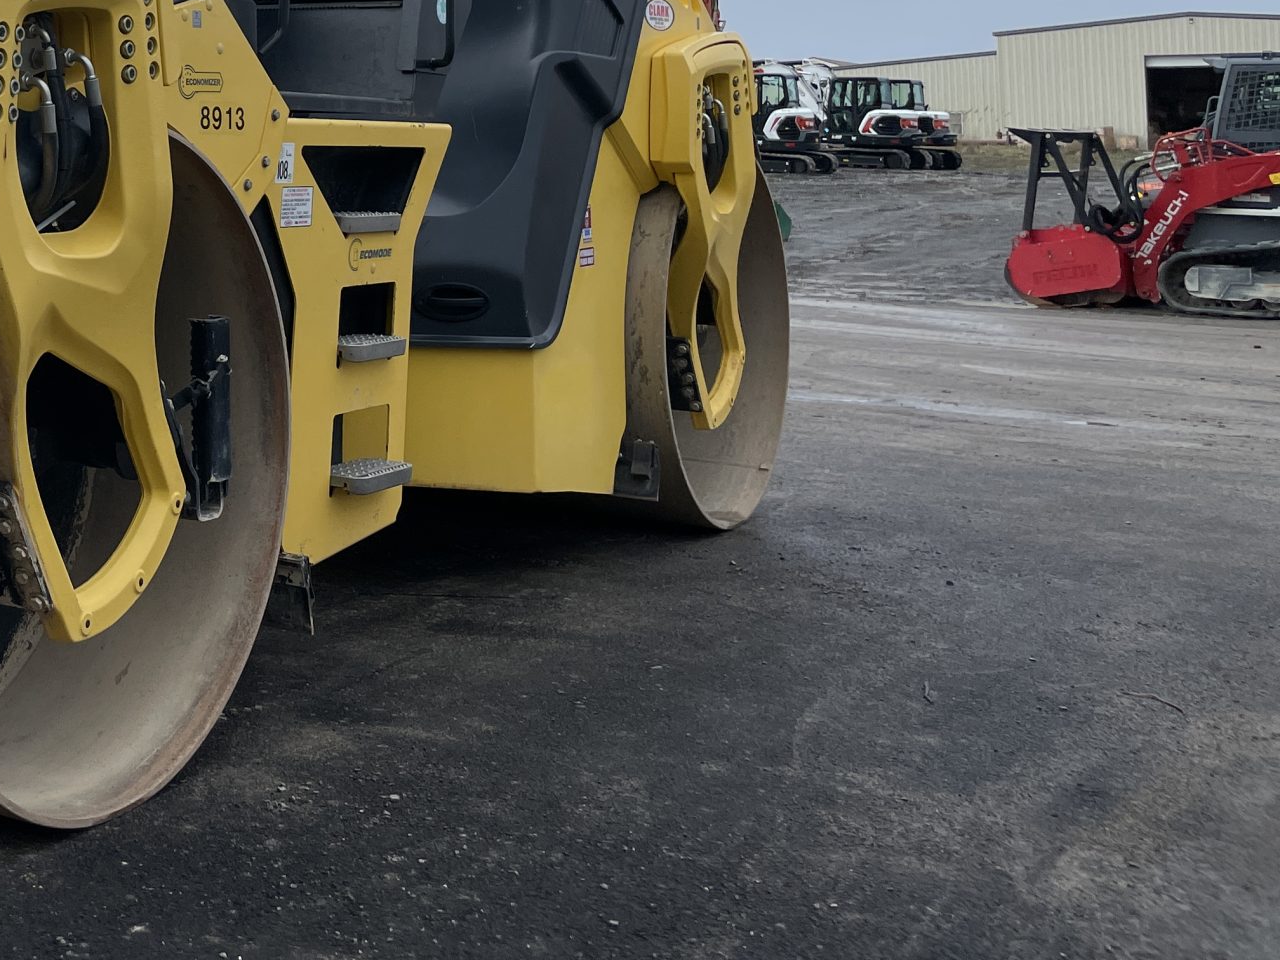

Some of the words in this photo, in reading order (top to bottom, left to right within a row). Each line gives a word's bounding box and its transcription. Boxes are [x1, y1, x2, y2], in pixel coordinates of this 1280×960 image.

[648, 3, 670, 18] CLARK
[185, 78, 221, 86] ECONOMIZER
[200, 106, 245, 130] 8913
[359, 248, 392, 260] ECOMODE
